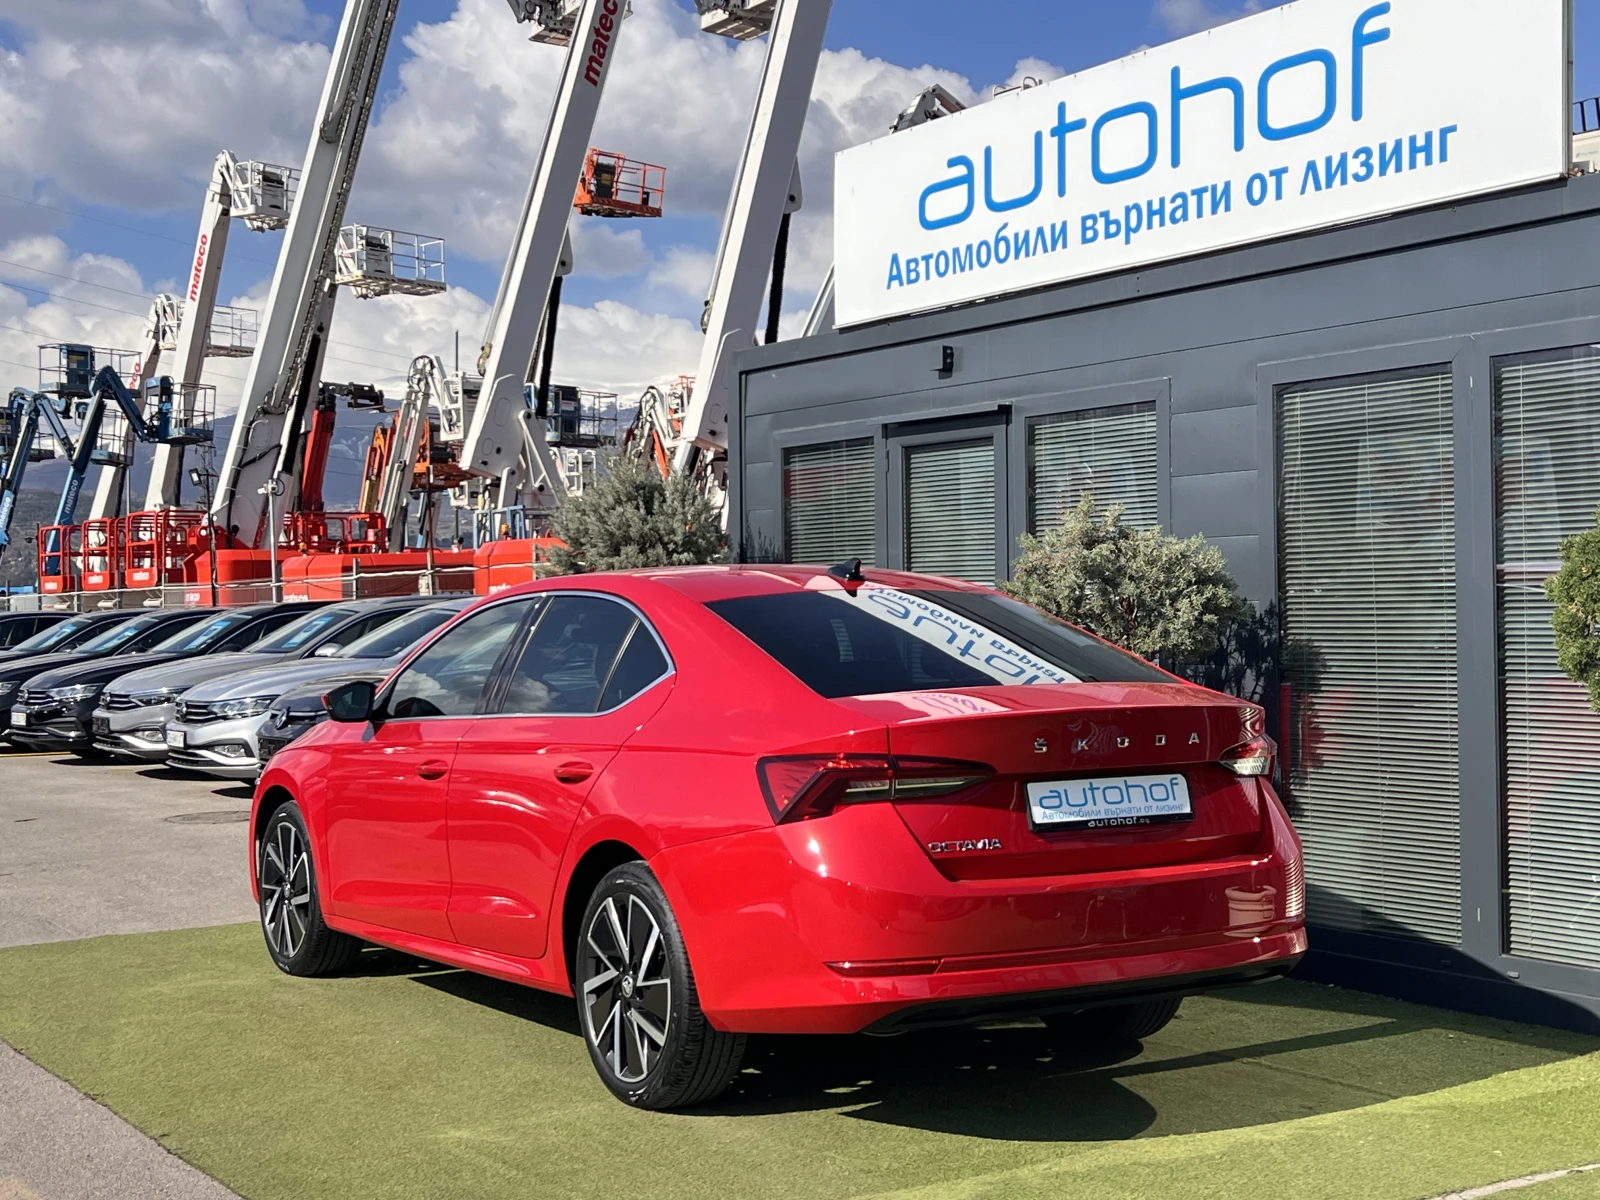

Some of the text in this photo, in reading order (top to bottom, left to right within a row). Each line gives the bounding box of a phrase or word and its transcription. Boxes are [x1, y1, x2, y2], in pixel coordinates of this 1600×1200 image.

[919, 1, 1391, 231] autohof
[887, 124, 1458, 290] Автомобили върнати от лизинг
[190, 236, 207, 302] mateco
[64, 479, 79, 514] mateco
[1039, 777, 1179, 810] autohof
[1042, 802, 1184, 821] Автомобили върнати от лизинг
[928, 838, 1002, 853] OCTAVIA
